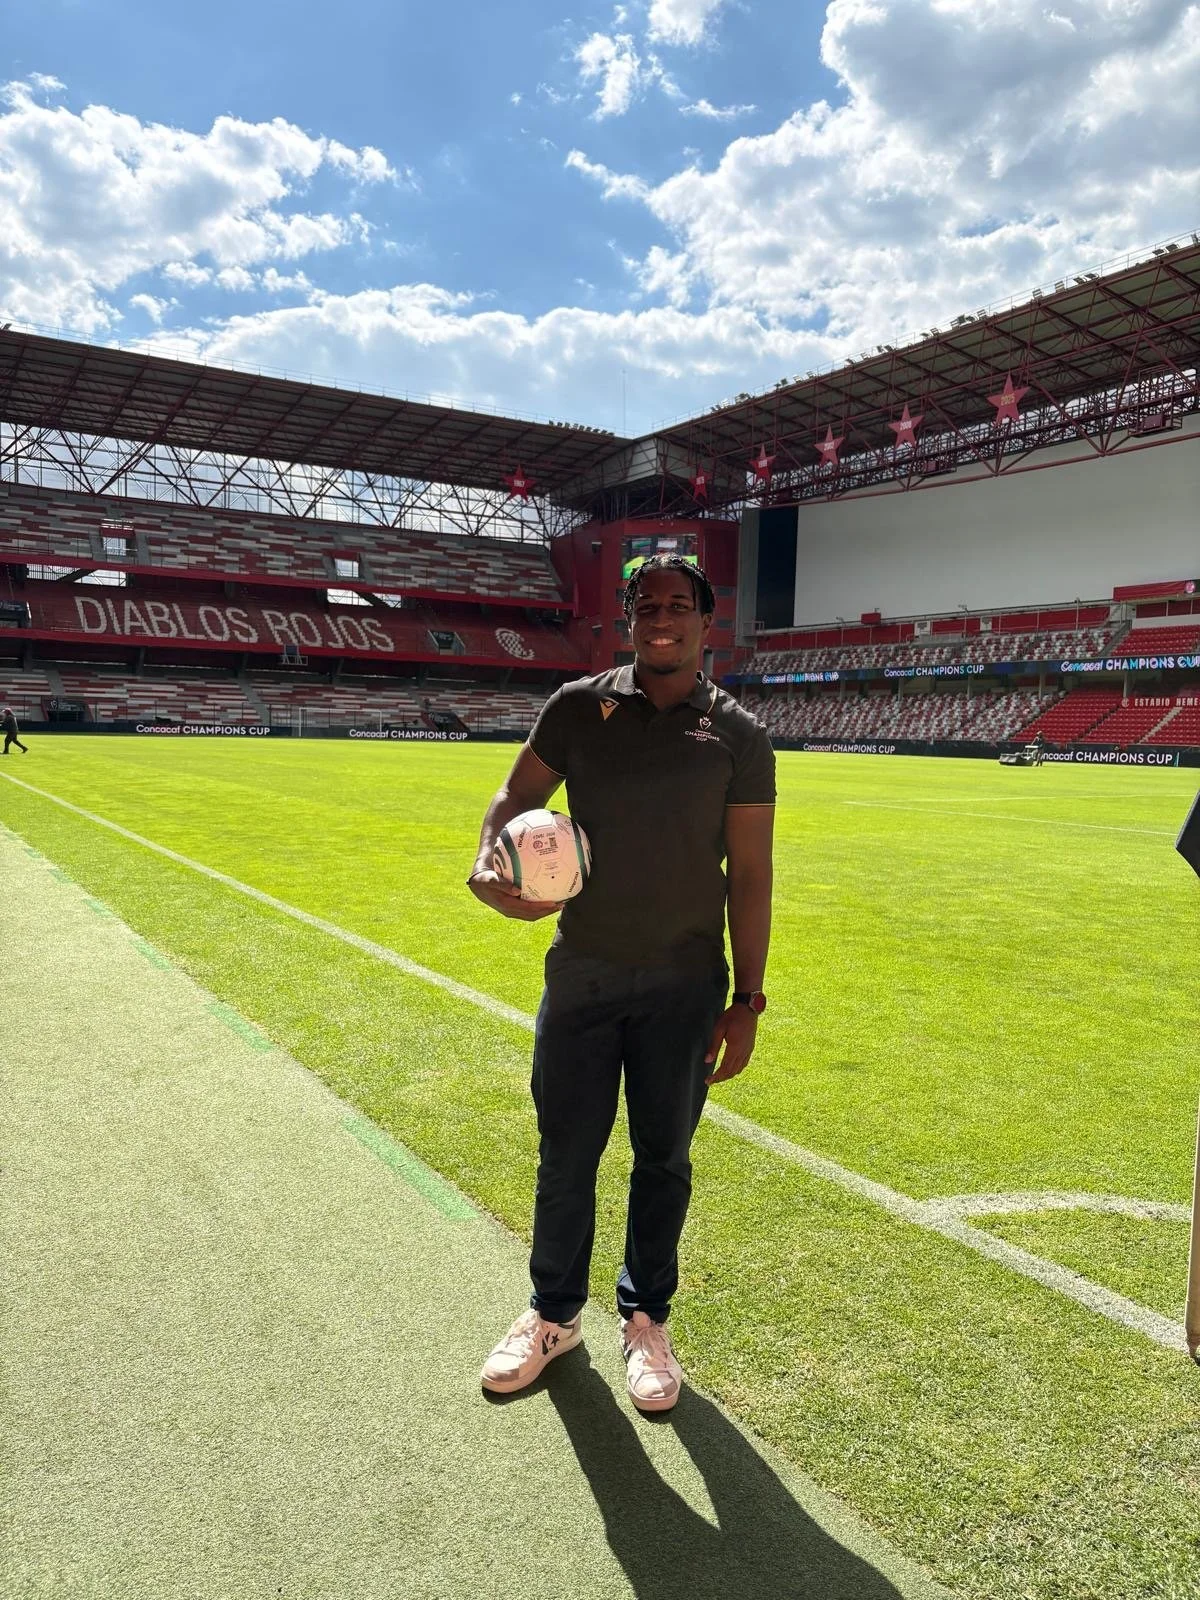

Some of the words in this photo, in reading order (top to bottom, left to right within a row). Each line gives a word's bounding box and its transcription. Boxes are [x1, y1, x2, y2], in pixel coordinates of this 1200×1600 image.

[74, 596, 258, 643] DIABLOS
[261, 610, 394, 651] ROJOS
[1105, 656, 1175, 670] CHAMPIONS
[916, 666, 965, 676] CHAMPIONS
[966, 664, 985, 673] CUP
[1134, 698, 1170, 706] ESTADIO
[1176, 697, 1200, 706] HEME
[136, 724, 181, 734] Concacaf
[183, 725, 247, 735] CHAMPIONS
[249, 726, 270, 735] CUP
[349, 728, 389, 738] Concacaf
[390, 730, 447, 740] CHAMPIONS
[449, 731, 468, 740] CUP
[832, 743, 877, 753] CHAMPIONS
[878, 745, 895, 754] CUP
[1075, 751, 1144, 763] CHAMPIONS
[1147, 753, 1173, 765] CUP
